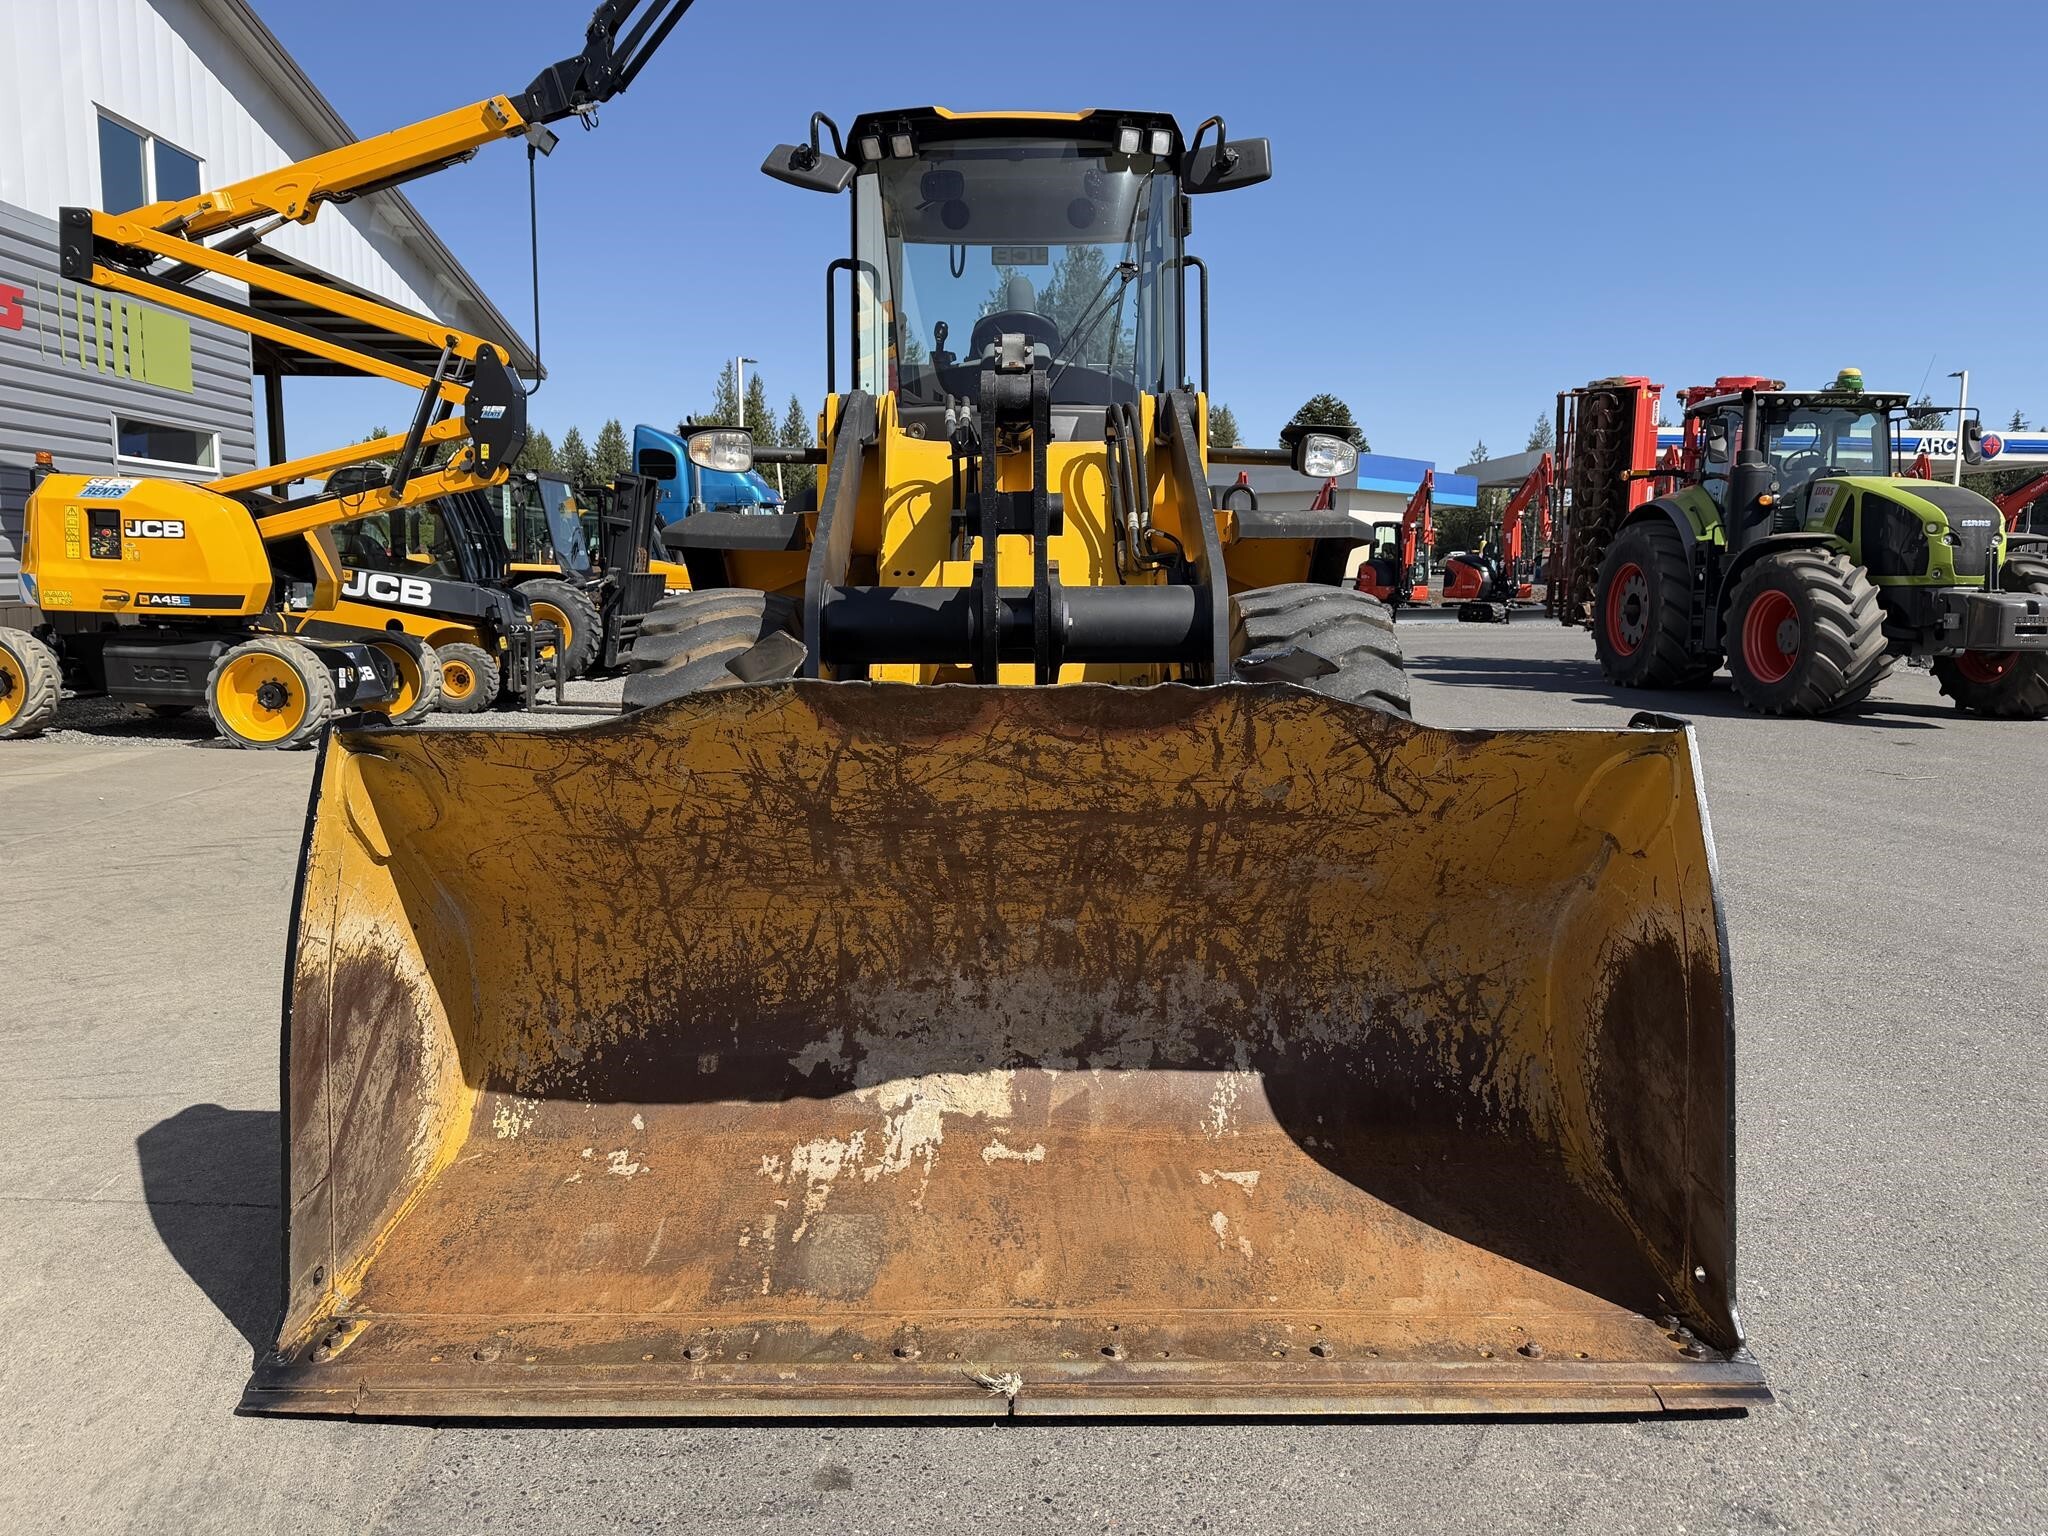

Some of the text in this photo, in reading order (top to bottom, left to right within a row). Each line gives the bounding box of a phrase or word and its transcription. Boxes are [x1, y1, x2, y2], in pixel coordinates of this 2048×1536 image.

[1917, 438, 1957, 453] ARC
[82, 487, 126, 496] RENTS
[125, 520, 184, 537] JCB
[342, 571, 432, 607] JCB
[150, 595, 190, 604] A45E
[132, 665, 190, 682] JCB
